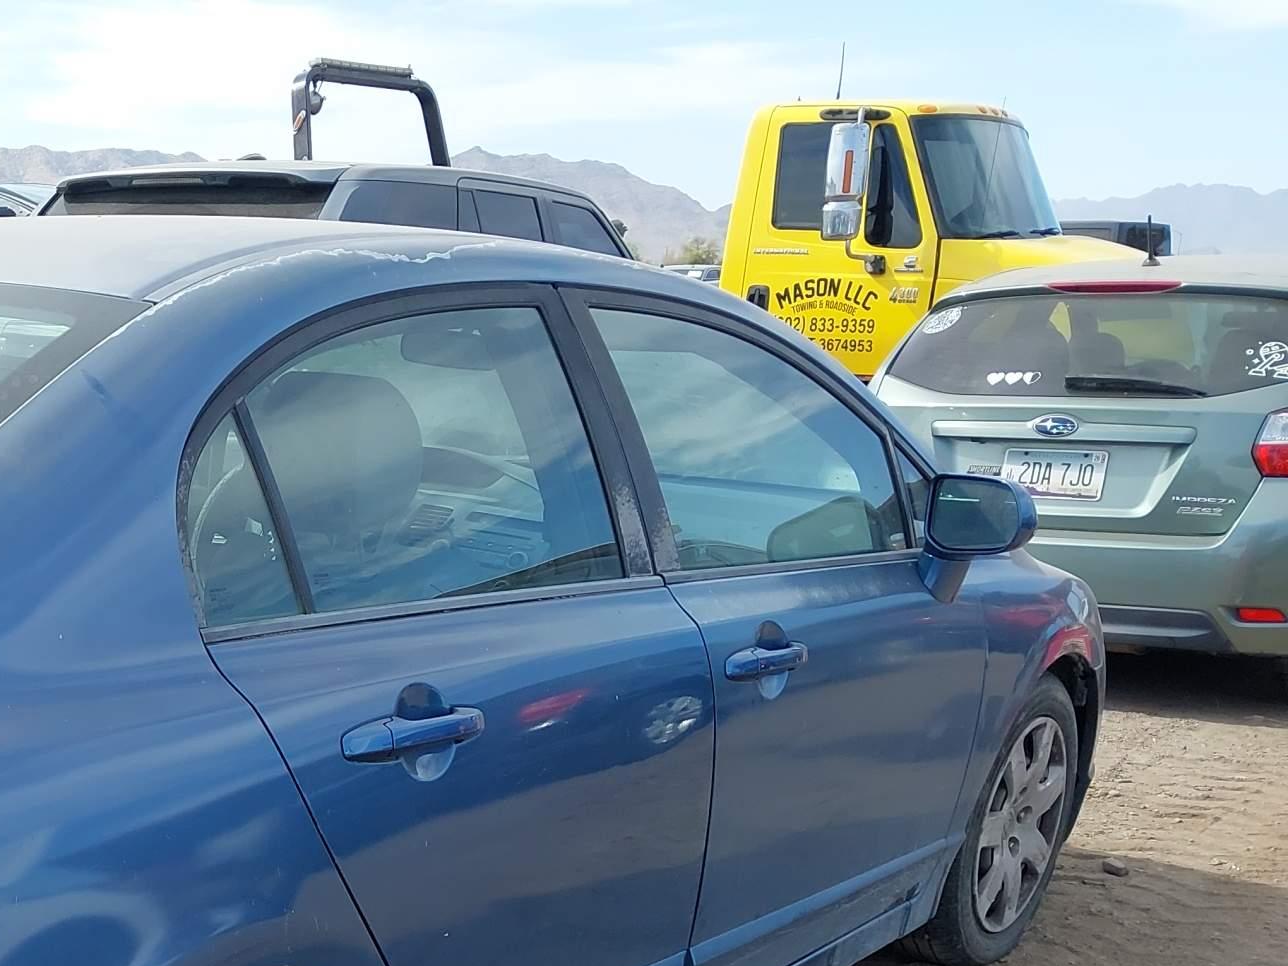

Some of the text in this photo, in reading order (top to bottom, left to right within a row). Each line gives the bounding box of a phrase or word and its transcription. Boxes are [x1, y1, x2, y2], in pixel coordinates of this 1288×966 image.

[776, 278, 878, 311] MASON LLC
[792, 300, 857, 316] TOWING & ROADSIDE
[809, 317, 875, 334] 833-9359
[1018, 462, 1052, 485] 2DA
